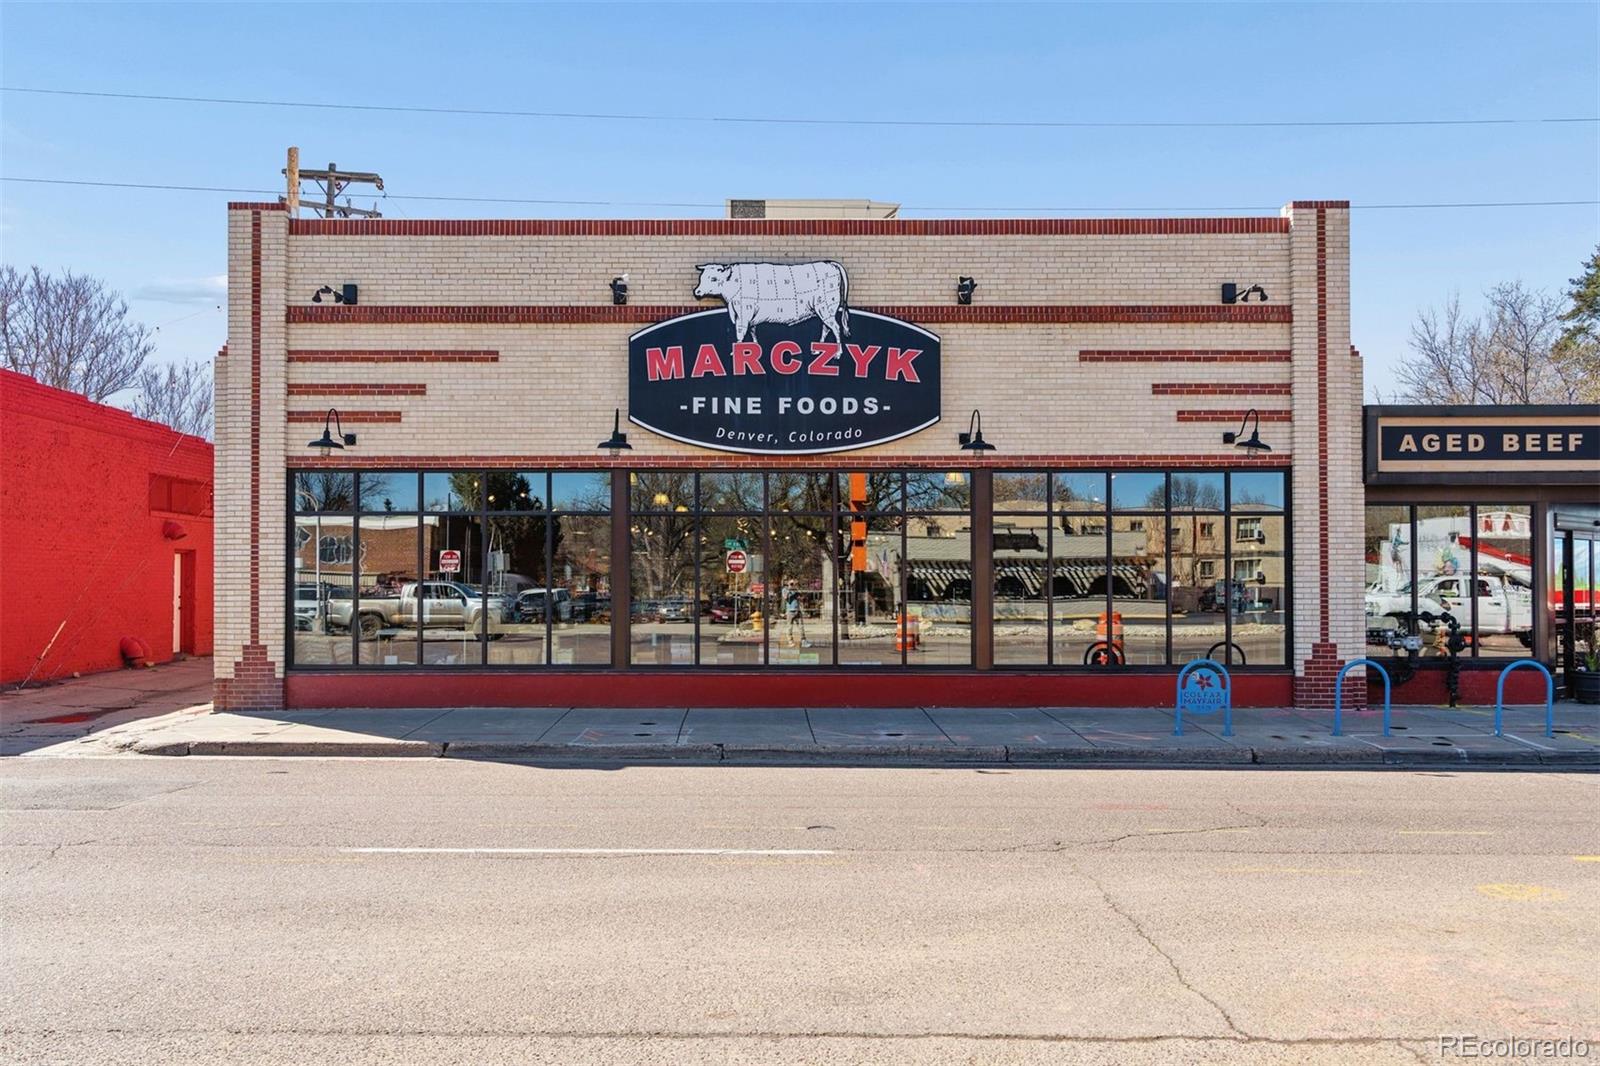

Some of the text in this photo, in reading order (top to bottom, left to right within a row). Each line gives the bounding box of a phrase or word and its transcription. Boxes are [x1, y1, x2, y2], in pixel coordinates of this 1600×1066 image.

[645, 341, 922, 382] MARCZYK
[715, 427, 863, 443] Denver, Colorado
[1399, 434, 1583, 452] AGED BEEF
